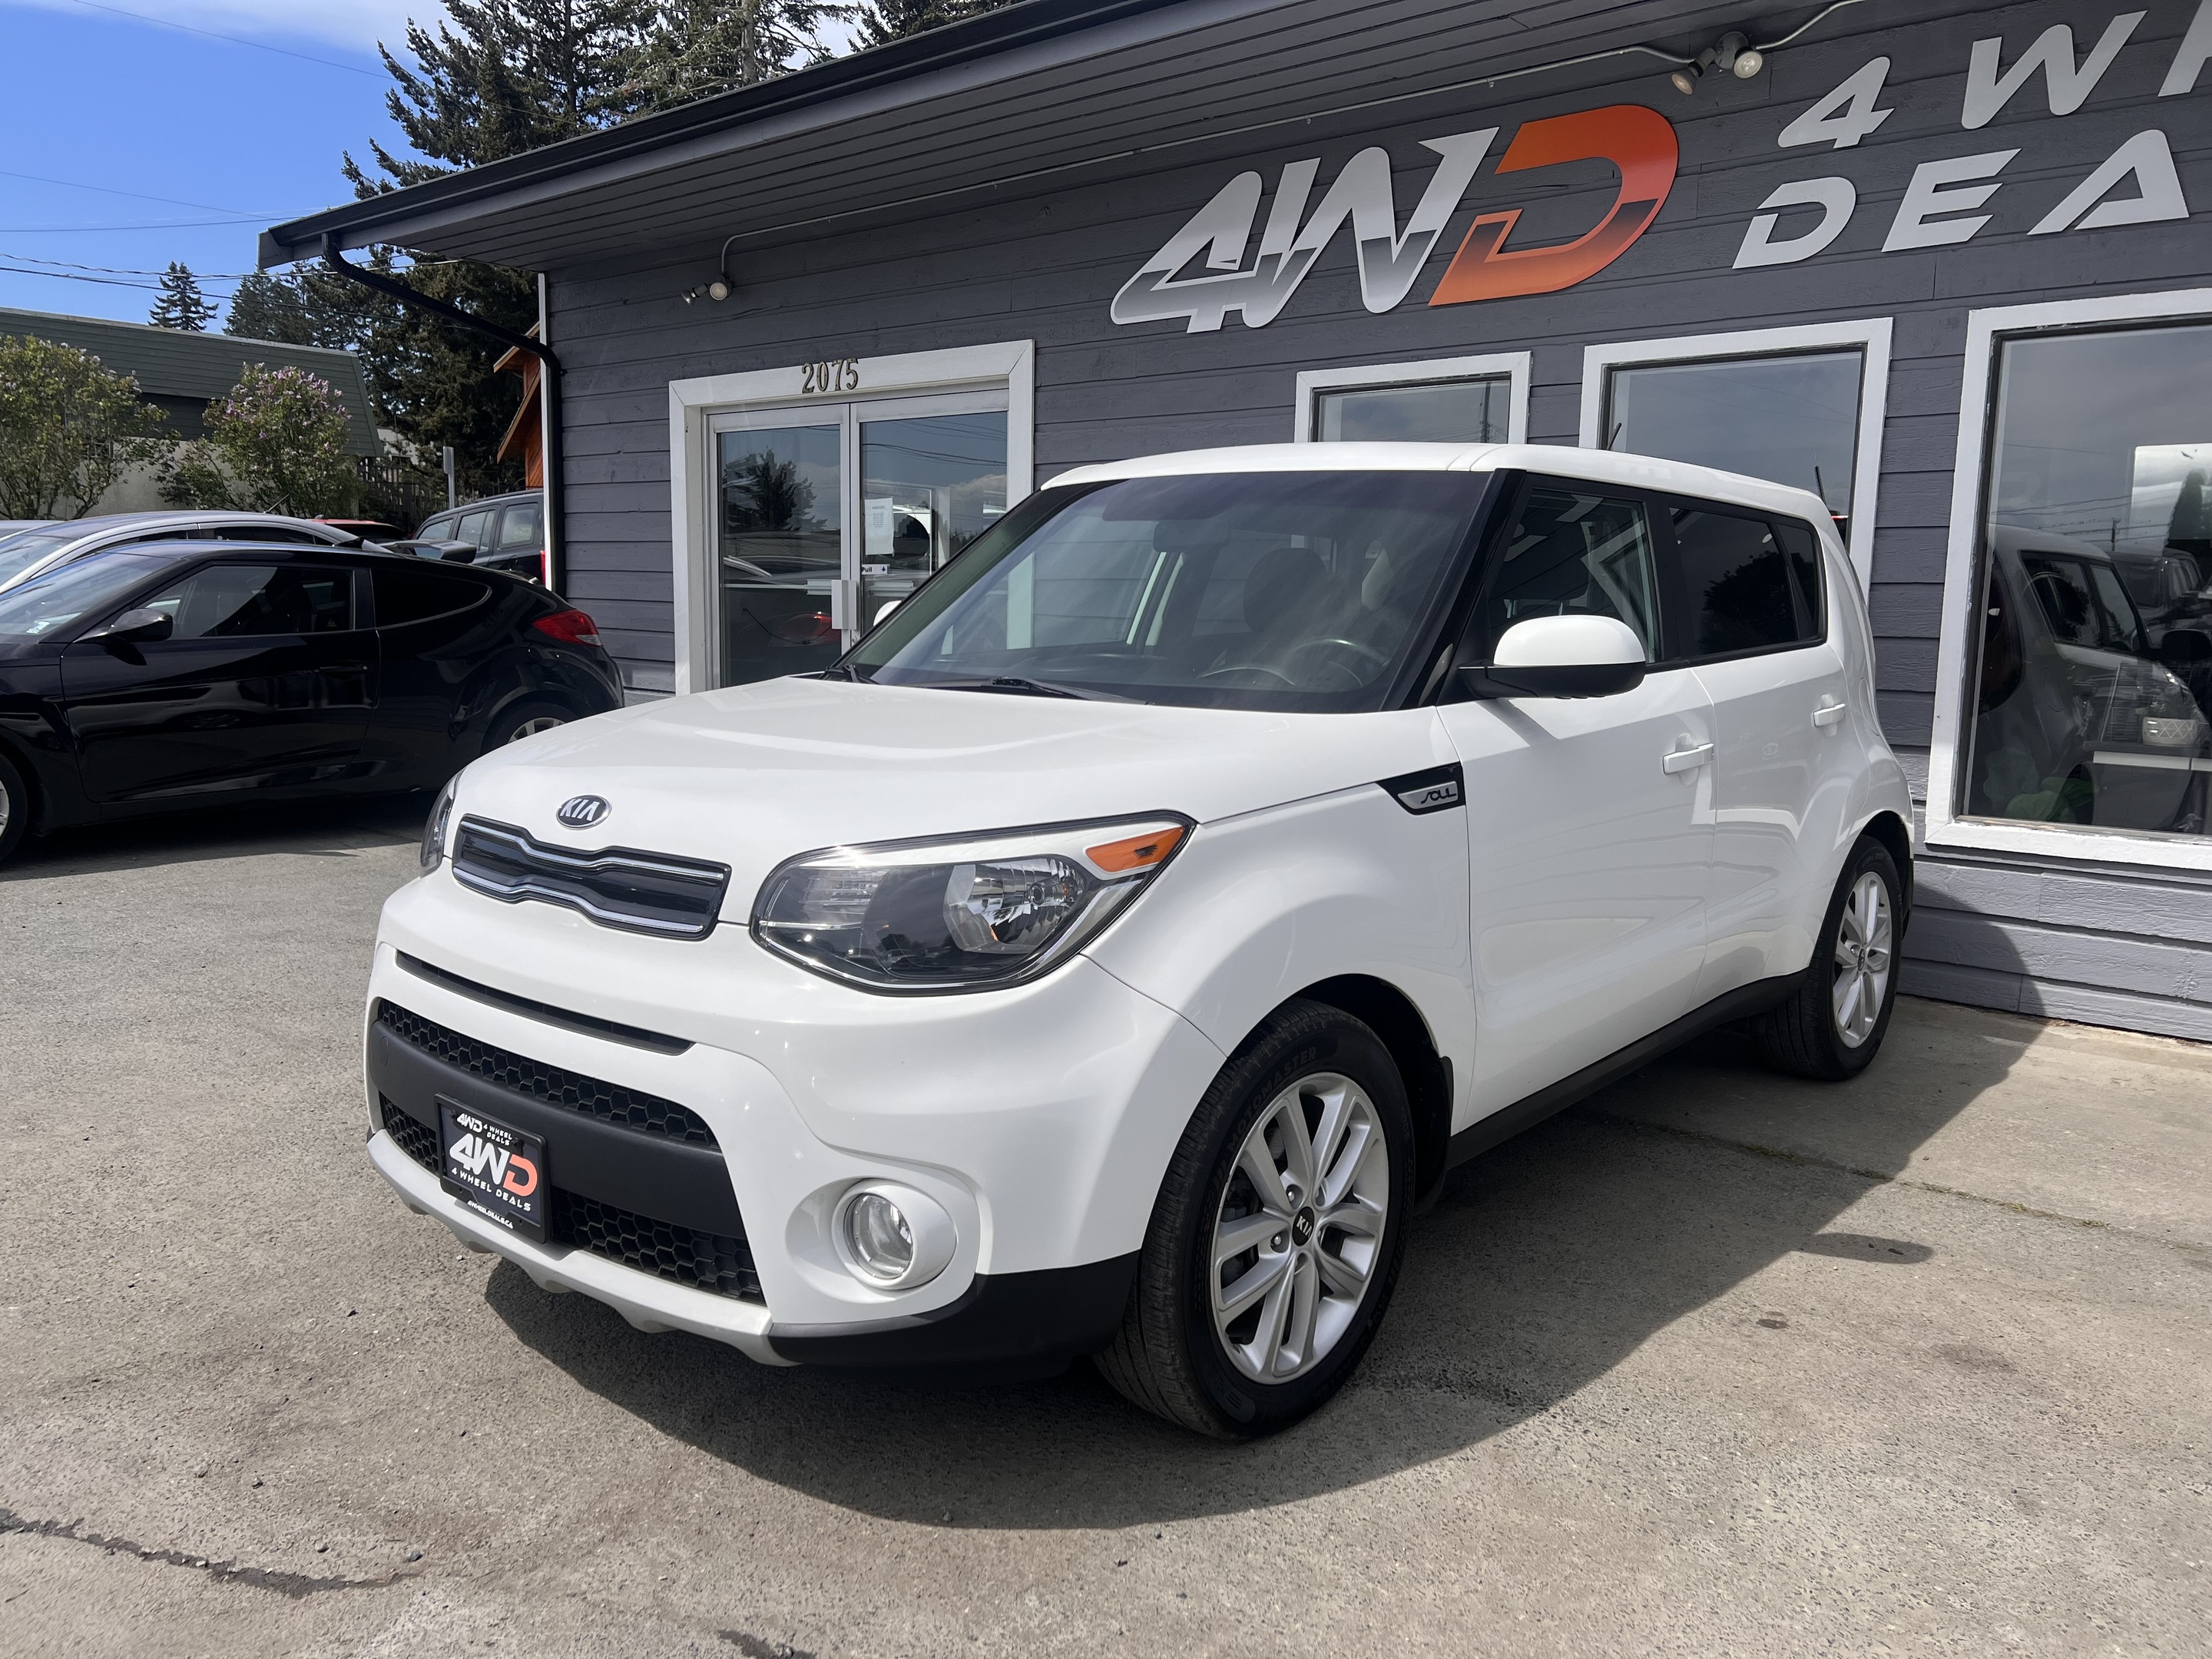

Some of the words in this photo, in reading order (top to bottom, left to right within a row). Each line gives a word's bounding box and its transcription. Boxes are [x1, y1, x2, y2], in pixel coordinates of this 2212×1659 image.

[1777, 56, 1895, 149] 4
[1111, 104, 1680, 333] 4WD
[802, 358, 858, 393] 2075
[559, 799, 600, 821] KIA
[1227, 1046, 1316, 1153] MOTOMASTER
[456, 1113, 482, 1133] 4WD
[487, 1131, 510, 1146] DEALS
[489, 1125, 512, 1140] WHEEL
[449, 1133, 538, 1197] 4WD
[451, 1167, 457, 1175] 4
[459, 1170, 492, 1193] WHEEL
[495, 1188, 531, 1212] DEALS
[1296, 1215, 1313, 1239] KIA
